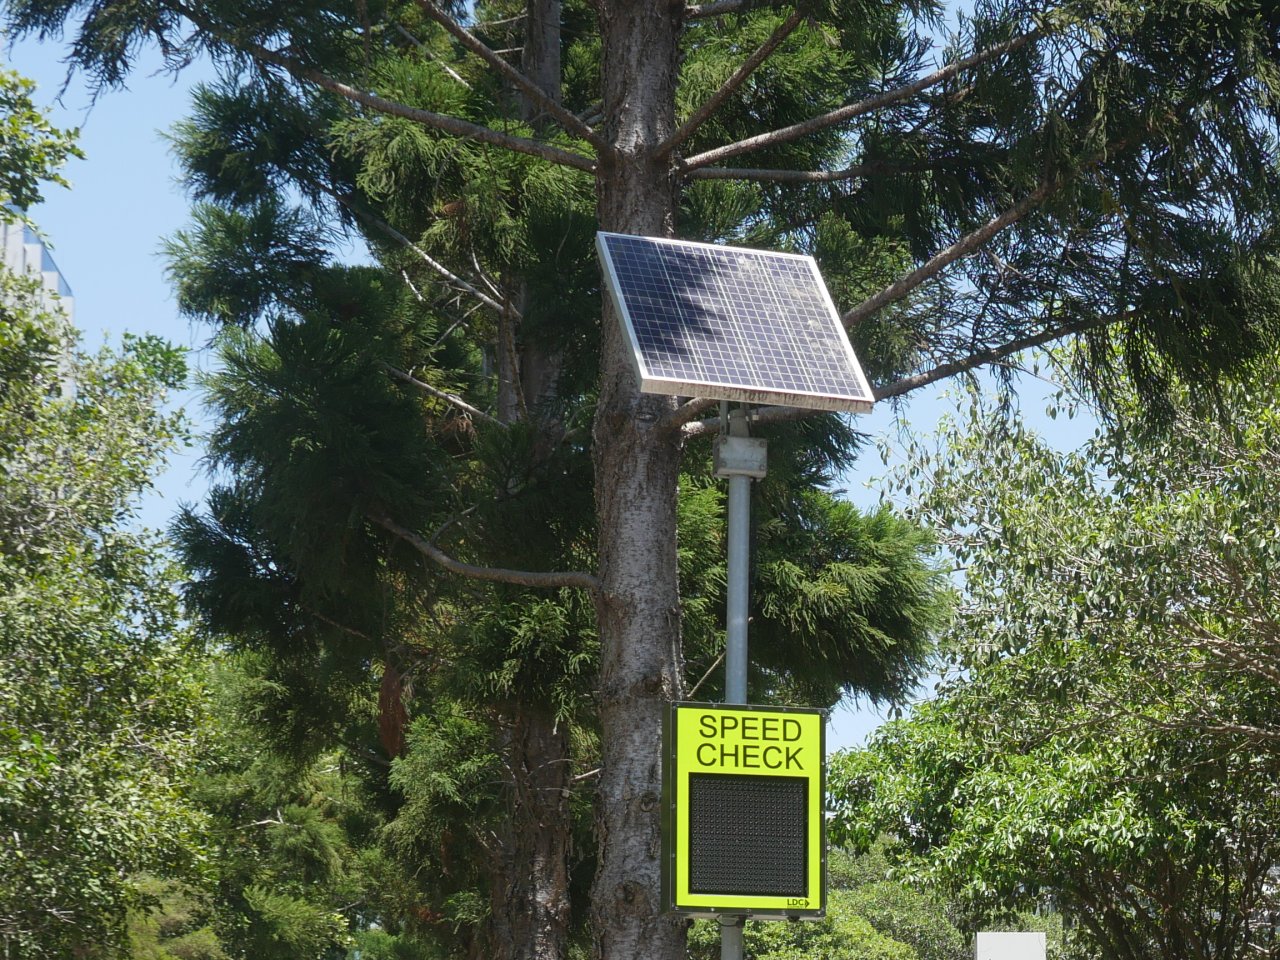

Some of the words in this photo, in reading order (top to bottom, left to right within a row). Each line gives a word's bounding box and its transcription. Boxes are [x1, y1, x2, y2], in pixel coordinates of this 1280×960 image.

[699, 715, 802, 742] SPEED
[696, 743, 804, 770] CHECK
[787, 898, 804, 906] LDC
